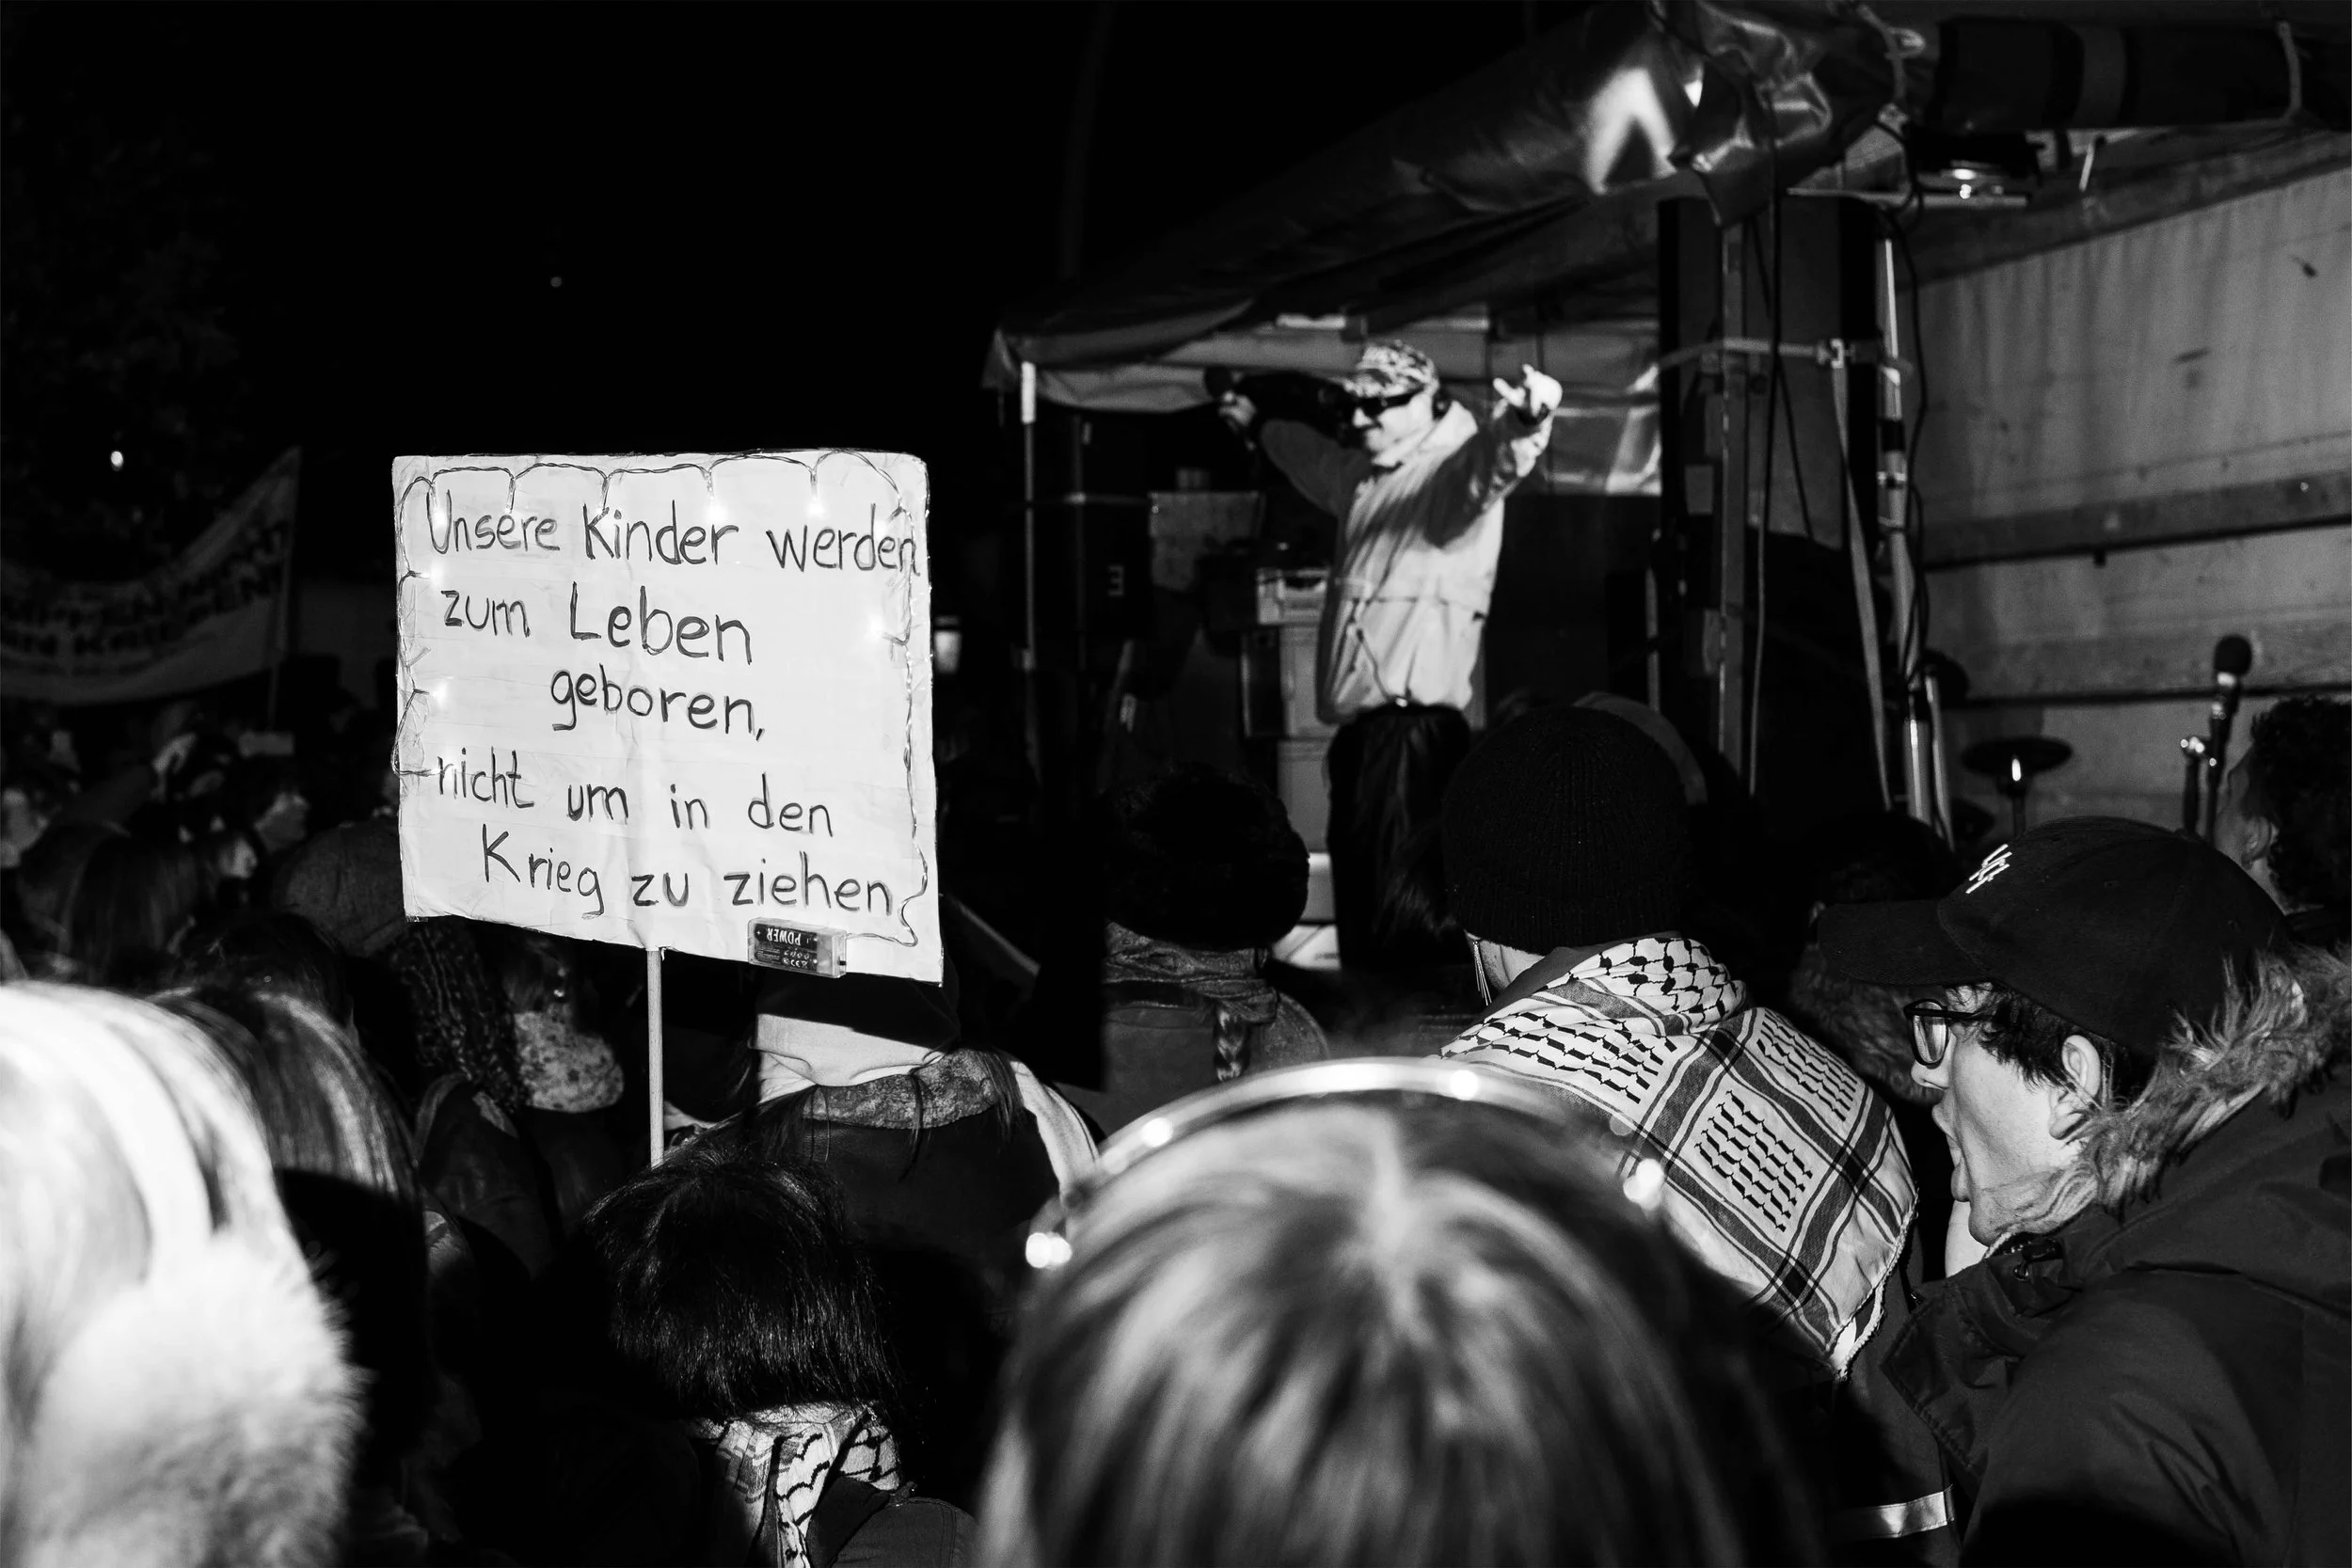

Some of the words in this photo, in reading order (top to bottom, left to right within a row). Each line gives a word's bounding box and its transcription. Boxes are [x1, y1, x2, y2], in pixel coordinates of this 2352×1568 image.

[425, 489, 562, 556] Unsere
[582, 500, 740, 565] Kinder
[766, 502, 921, 578] werden
[440, 589, 532, 639] zum
[569, 581, 754, 665] Leben
[550, 664, 767, 741] geboren,
[437, 747, 535, 810] nicht
[566, 782, 630, 824] um
[669, 783, 711, 831] in
[747, 771, 834, 838] den
[481, 822, 605, 920] Krieg
[630, 872, 691, 908] zu
[723, 850, 895, 916] ziehen
[767, 927, 802, 946] POWER
